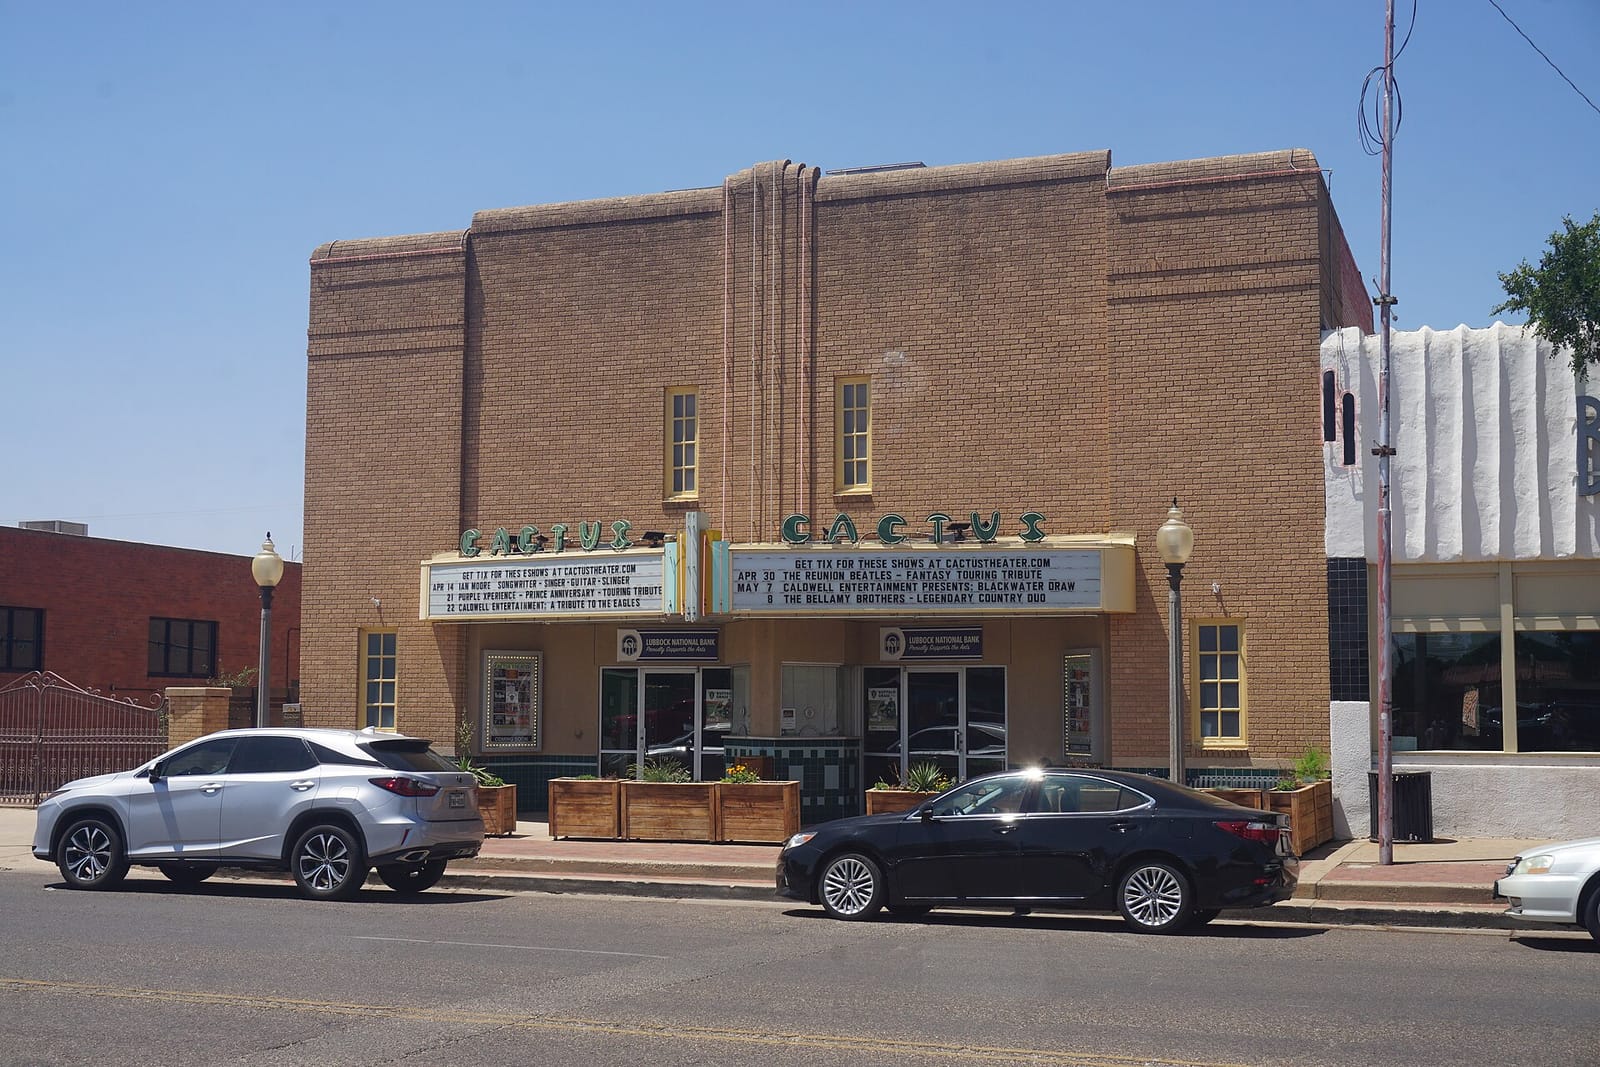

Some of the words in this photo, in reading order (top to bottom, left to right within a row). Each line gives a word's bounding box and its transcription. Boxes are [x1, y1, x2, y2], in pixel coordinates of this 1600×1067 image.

[782, 512, 1046, 544] CACTUS
[460, 519, 634, 556] CACTUS
[795, 560, 812, 569] GET
[817, 560, 832, 569] TIX
[837, 560, 854, 569] FOR
[858, 560, 887, 568] THESE
[892, 559, 924, 568] SHOWS
[929, 559, 940, 568] AT
[946, 559, 1050, 568] CACTUSTHEATER.COM
[463, 572, 473, 580] GET
[477, 571, 488, 579] TIX
[552, 568, 561, 576] AT
[564, 564, 636, 576] CACTUSTHEATER.COM
[738, 572, 756, 580] APR
[764, 572, 775, 580] 30
[784, 572, 800, 580] THE
[805, 571, 845, 580] REUNION
[850, 571, 892, 580] BEATLES
[906, 571, 951, 580] FANTASY
[957, 570, 997, 579] TOURING
[1002, 570, 1042, 579] TRIBUTE
[433, 583, 444, 591] APR
[459, 582, 469, 590] IAN
[471, 582, 491, 590] MOORE
[498, 580, 536, 589] SONGWRITER
[738, 583, 759, 592] MAY
[767, 583, 772, 592] 7
[783, 583, 833, 592] CALDWELL
[840, 582, 918, 592] ENTERTAINMENT
[978, 582, 1044, 591] BLACKWATER
[1048, 582, 1075, 591] DRAW
[447, 594, 453, 602] 21
[458, 593, 480, 601] PURPLE
[483, 591, 516, 600] XPERIENCE
[526, 590, 547, 599] PRINCE
[550, 589, 594, 598] ANNIVERSARY
[603, 587, 630, 596] TOURING
[634, 586, 662, 595] TRIBUTE
[767, 595, 773, 603] 8
[784, 595, 801, 603] THE
[806, 594, 850, 603] BELLAMY
[856, 594, 905, 603] BROTHERS
[917, 594, 973, 603] LEGENDARY
[979, 594, 1022, 603] COUNTRY
[1027, 593, 1046, 602] DUO
[447, 604, 455, 612] 22
[459, 603, 489, 611] CALDWELL
[550, 601, 555, 609] A
[557, 600, 587, 609] TRIBUTE
[591, 600, 598, 608] TO
[598, 599, 611, 608] THE
[614, 598, 640, 608] EAGLES
[909, 636, 934, 644] LUBBOCK
